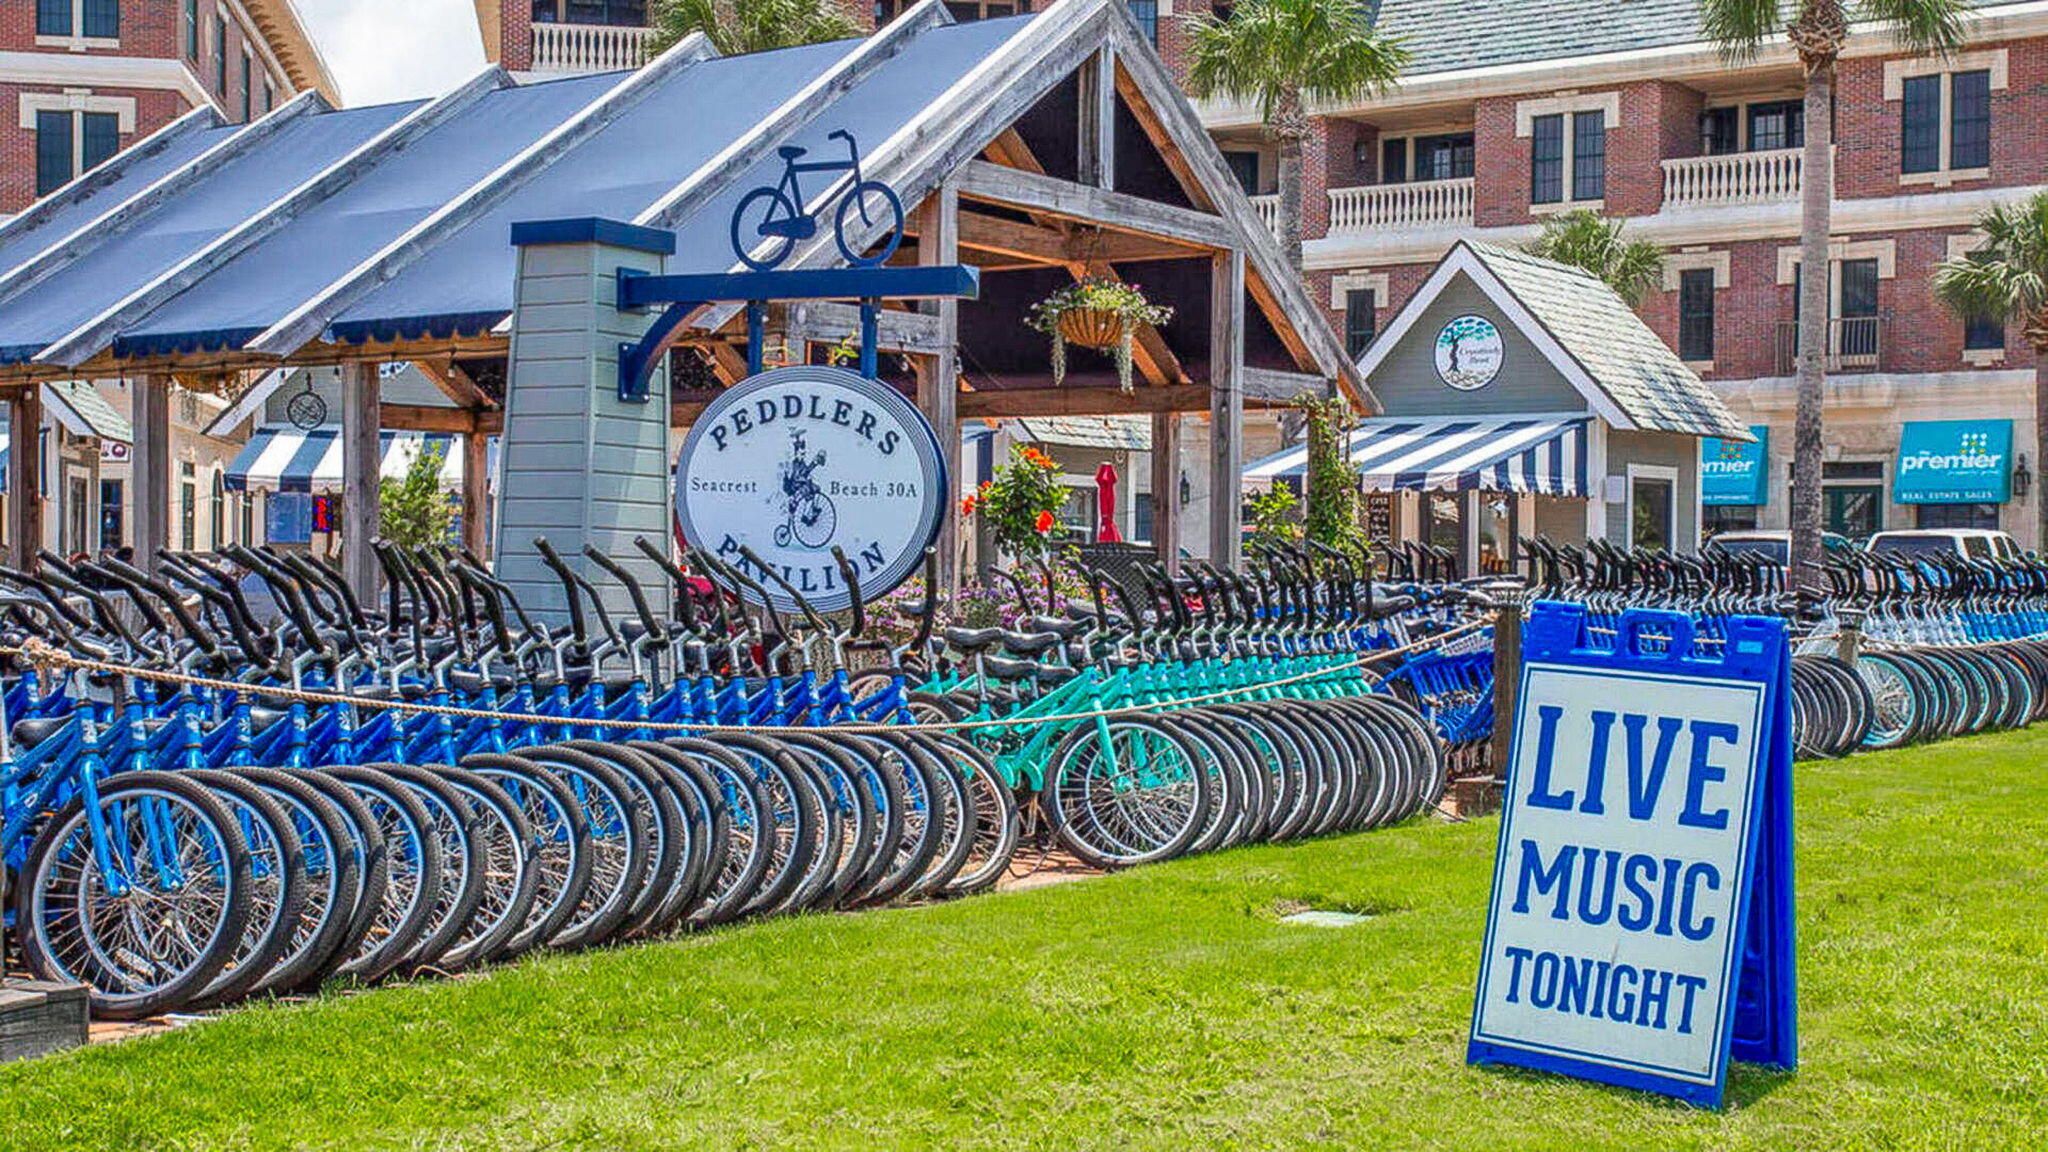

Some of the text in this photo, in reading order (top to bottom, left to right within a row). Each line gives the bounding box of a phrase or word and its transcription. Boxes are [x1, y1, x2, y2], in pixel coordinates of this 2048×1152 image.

[710, 395, 900, 455] PEDDLERS
[691, 477, 918, 498] Seacrest Beach 30A
[1527, 706, 1739, 830] LIVE
[1512, 840, 1721, 941] MUSIC
[1505, 947, 1706, 1034] TONIGHT
